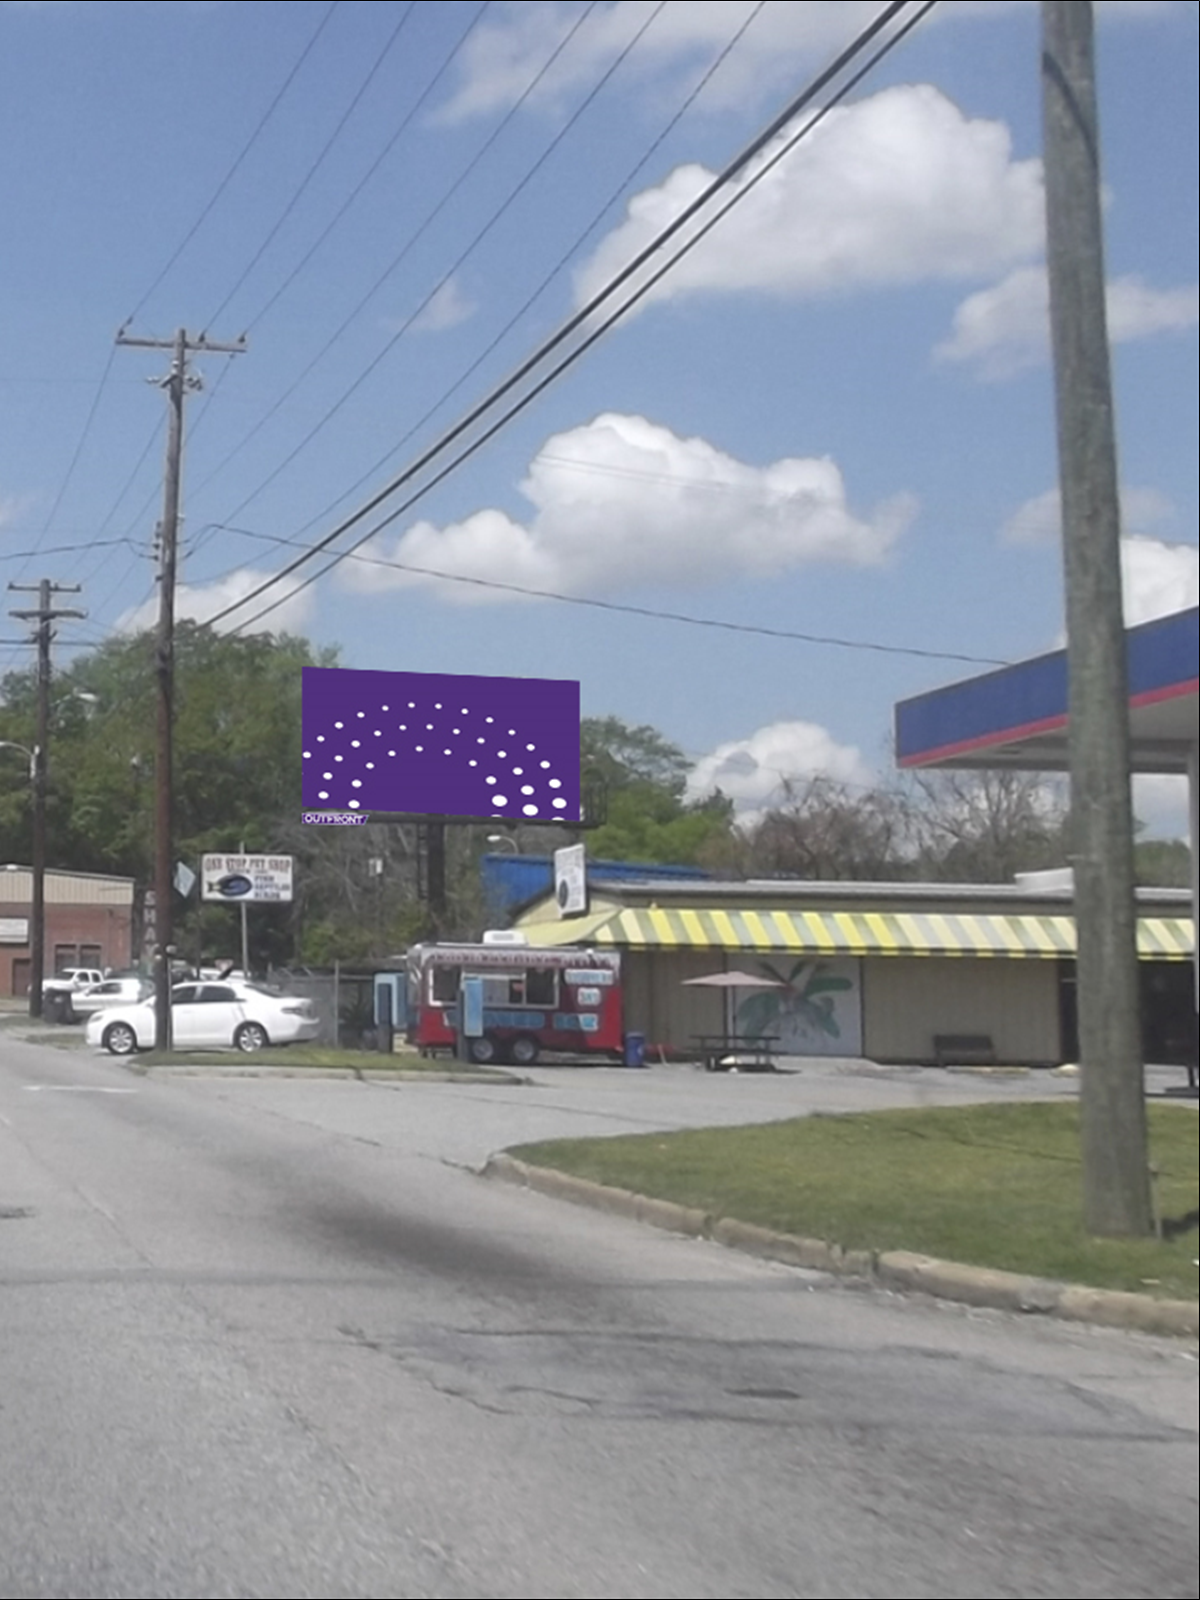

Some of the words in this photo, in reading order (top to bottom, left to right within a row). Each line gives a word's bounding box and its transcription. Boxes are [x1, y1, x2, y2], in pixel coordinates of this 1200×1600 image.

[304, 814, 364, 825] OUTFRONT
[205, 858, 222, 872] ONE
[226, 858, 247, 870] STOP
[249, 859, 266, 870] PET
[268, 860, 290, 873] SHOP
